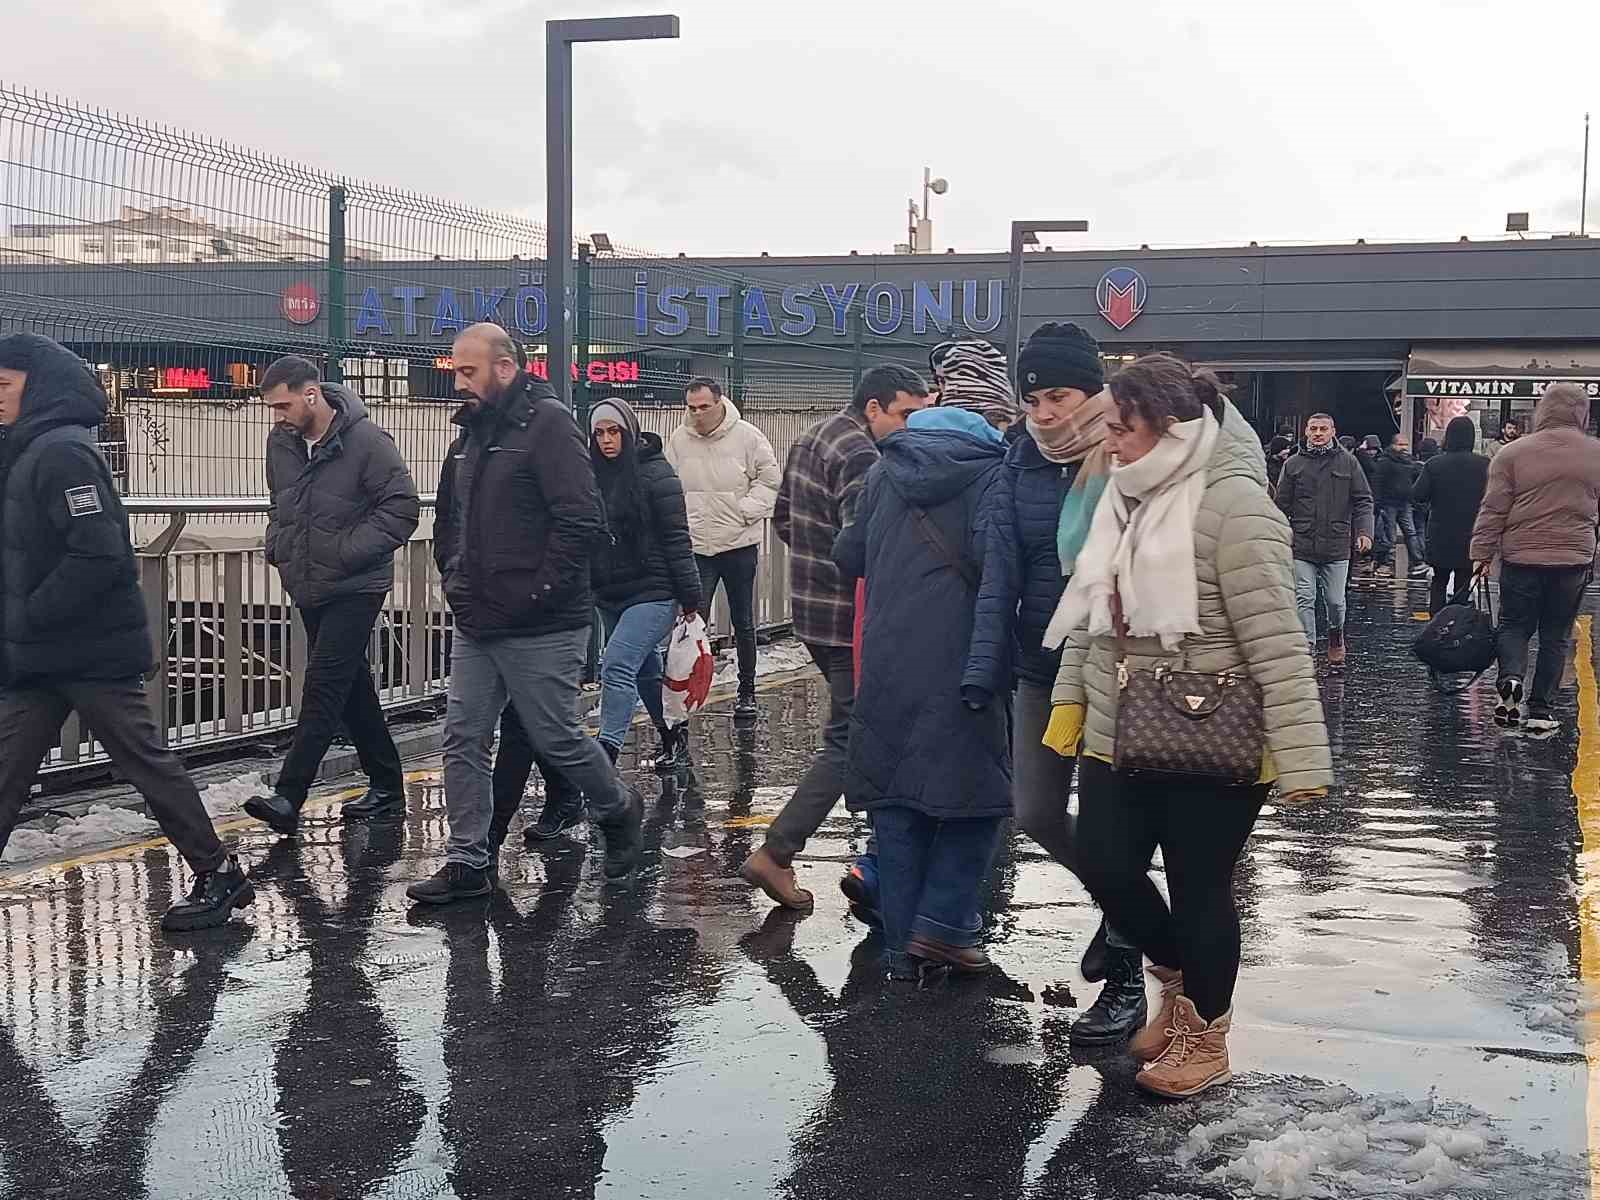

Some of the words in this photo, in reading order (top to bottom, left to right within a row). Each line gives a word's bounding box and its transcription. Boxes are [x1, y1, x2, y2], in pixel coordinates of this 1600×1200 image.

[355, 271, 577, 337] ATAKÖ
[633, 271, 1003, 337] İSTASYONU
[1425, 380, 1515, 395] VİTAMİN
